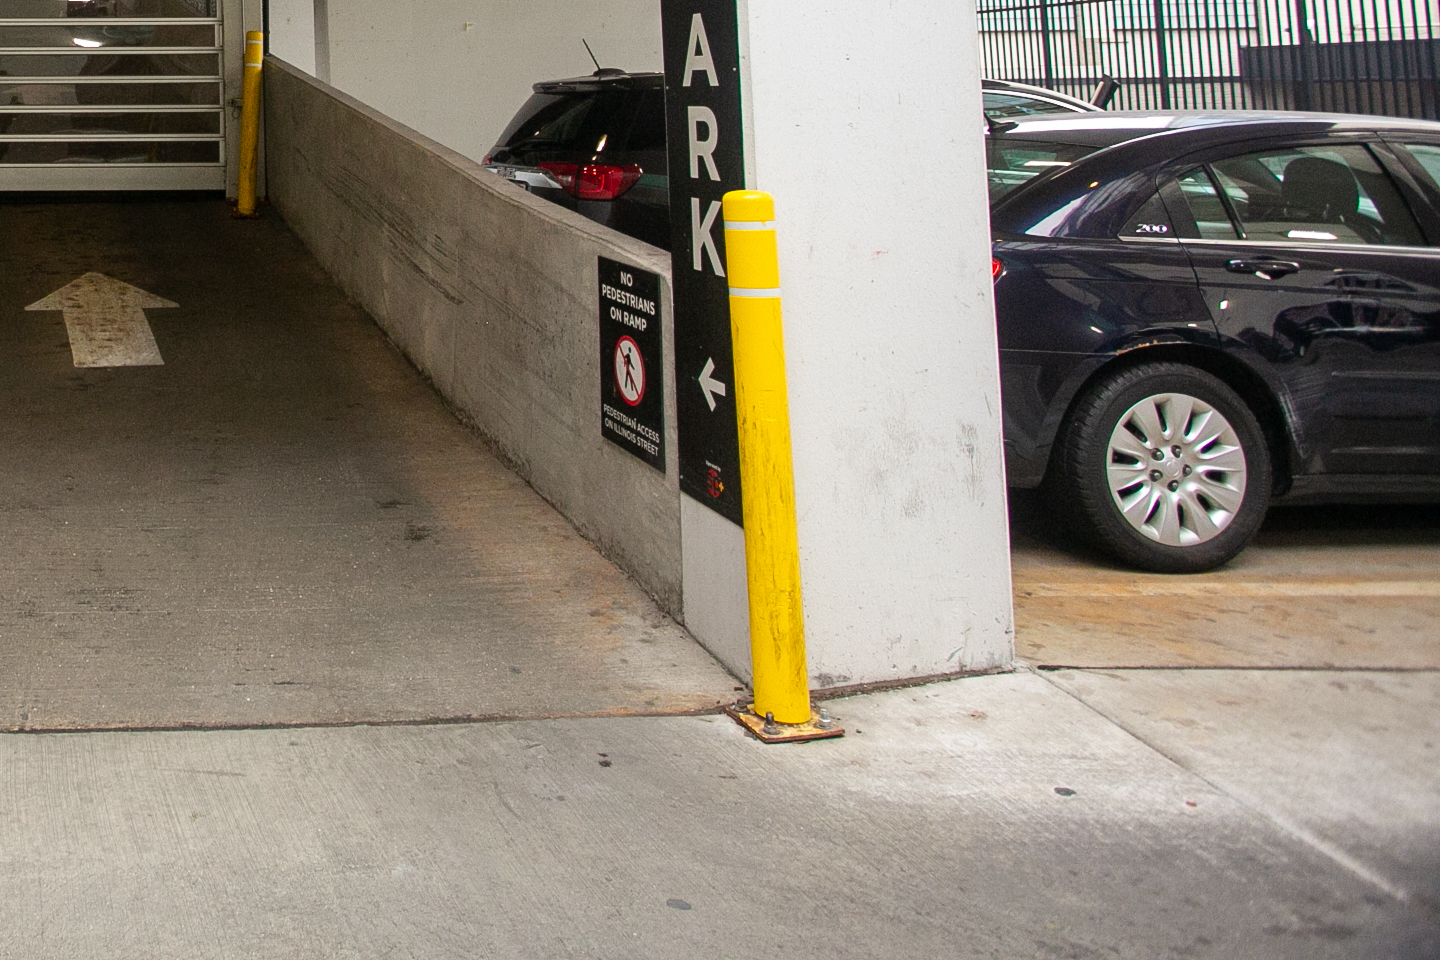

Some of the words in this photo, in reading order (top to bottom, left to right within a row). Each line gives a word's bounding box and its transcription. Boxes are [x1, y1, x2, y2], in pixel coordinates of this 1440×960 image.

[1136, 224, 1168, 233] 200
[620, 271, 633, 287] NO
[602, 283, 655, 316] PEDESTRIANS
[610, 306, 622, 322] ON
[623, 311, 647, 331] RAMP
[603, 403, 637, 430] PEDESTRIAN
[637, 423, 660, 443] ACCESS
[604, 417, 613, 430] ON
[614, 422, 636, 444] ILLINOIS
[637, 436, 659, 456] STREET
